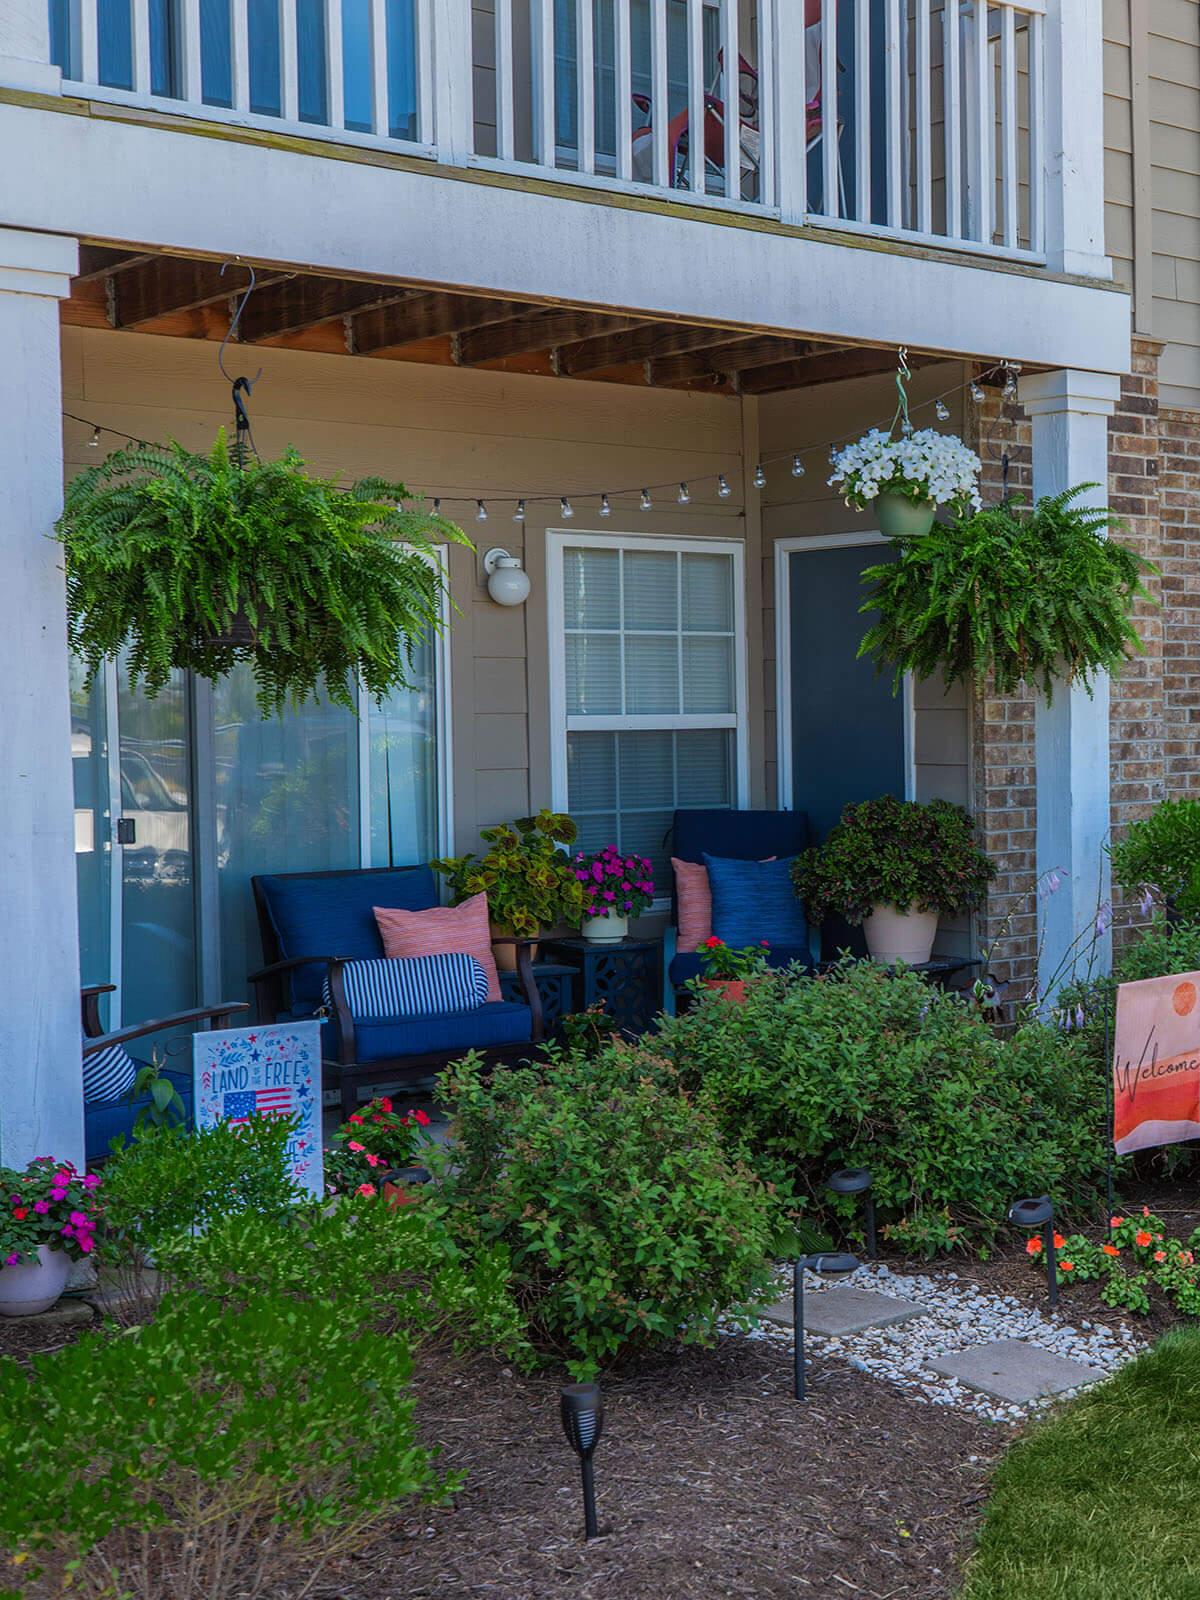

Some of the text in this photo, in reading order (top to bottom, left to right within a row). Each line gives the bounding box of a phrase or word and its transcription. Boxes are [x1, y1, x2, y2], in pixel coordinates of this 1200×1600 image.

[212, 1066, 249, 1094] LAND
[265, 1060, 303, 1087] FREE
[1115, 1025, 1199, 1103] Welcome
